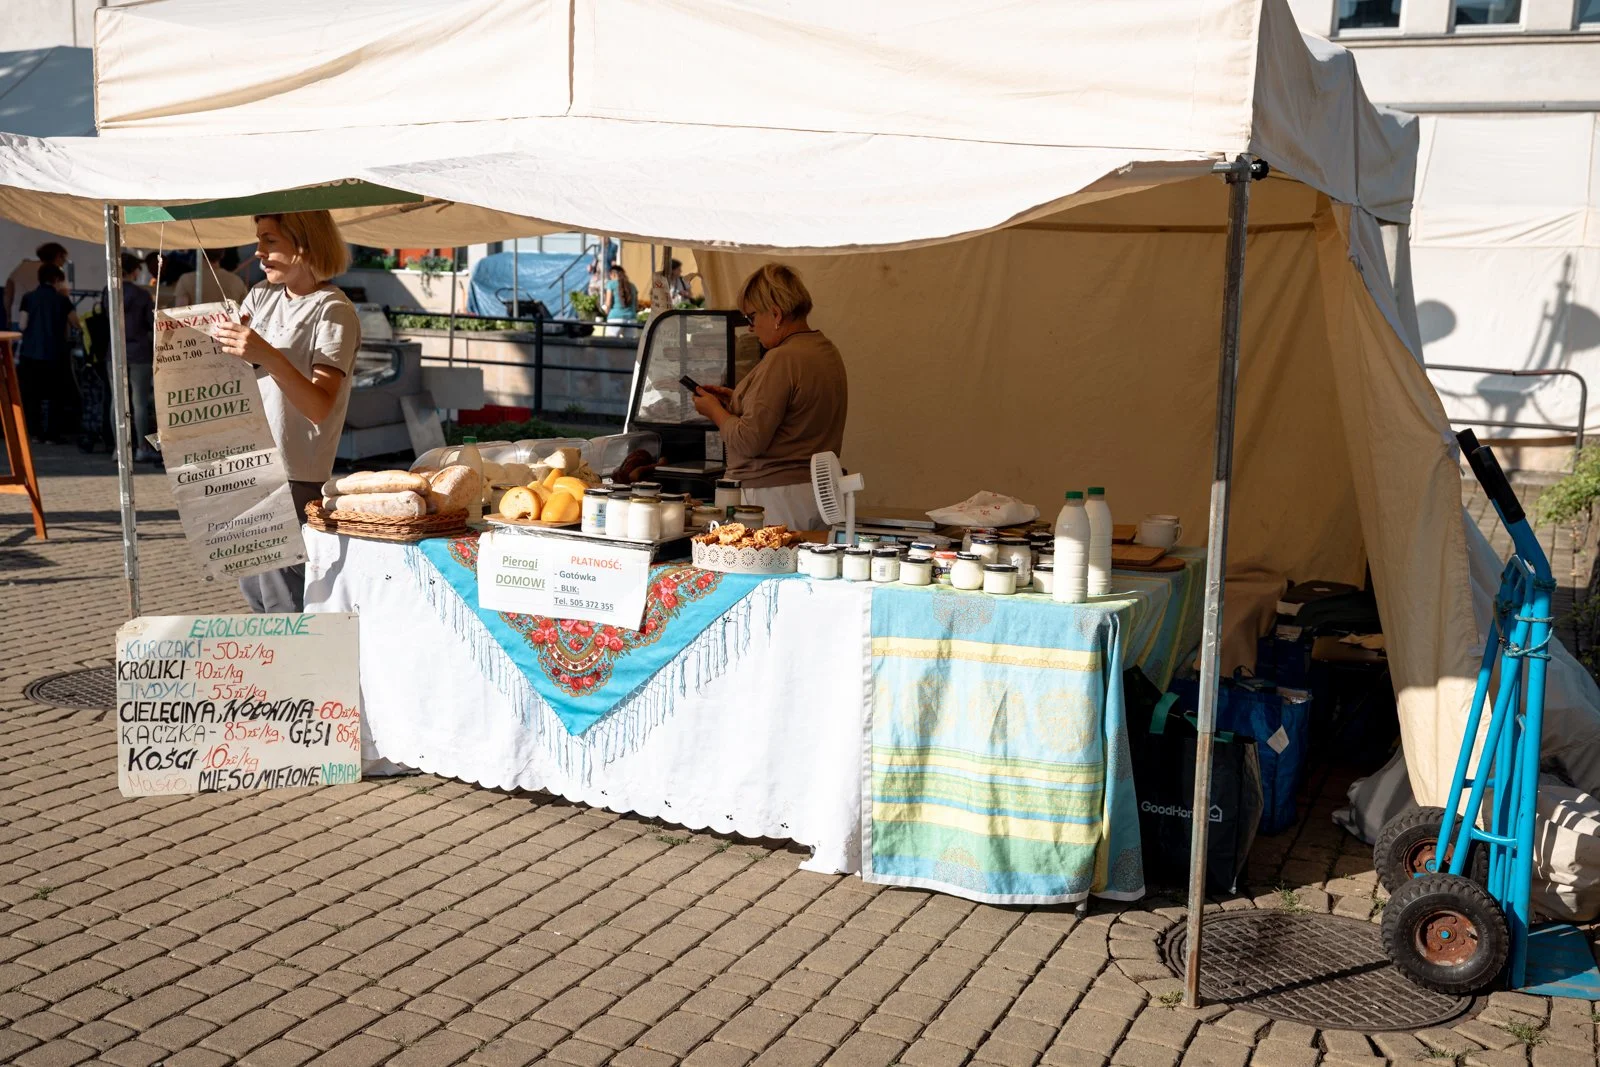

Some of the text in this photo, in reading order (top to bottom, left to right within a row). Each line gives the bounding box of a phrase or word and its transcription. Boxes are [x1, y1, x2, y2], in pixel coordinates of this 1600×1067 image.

[156, 312, 229, 332] PRASZAMY
[177, 338, 197, 350] 7.00
[183, 348, 202, 360] 7.00
[167, 380, 241, 406] PIEROGI
[168, 399, 251, 427] DOMOWE
[184, 442, 256, 464] Ekologiczne
[177, 467, 215, 484] Ciasta
[226, 453, 272, 473] TORTY
[204, 476, 257, 496] Domowe
[207, 511, 275, 532] Przyjmujemy
[205, 523, 284, 546] zamówienia na
[209, 535, 288, 561] ekologiczne
[224, 551, 281, 571] warzywa
[502, 555, 538, 570] Pierogi
[571, 555, 622, 570] PŁATNOŚĆ:
[559, 570, 597, 582] Gotówka
[561, 584, 580, 594] BLIK:
[554, 597, 614, 611] Tel. 505 372 355
[188, 614, 317, 638] EKOLOGICZNE
[121, 724, 206, 745] KACZKA
[289, 719, 331, 747] GĘSI
[1141, 801, 1193, 818] GoodHo
